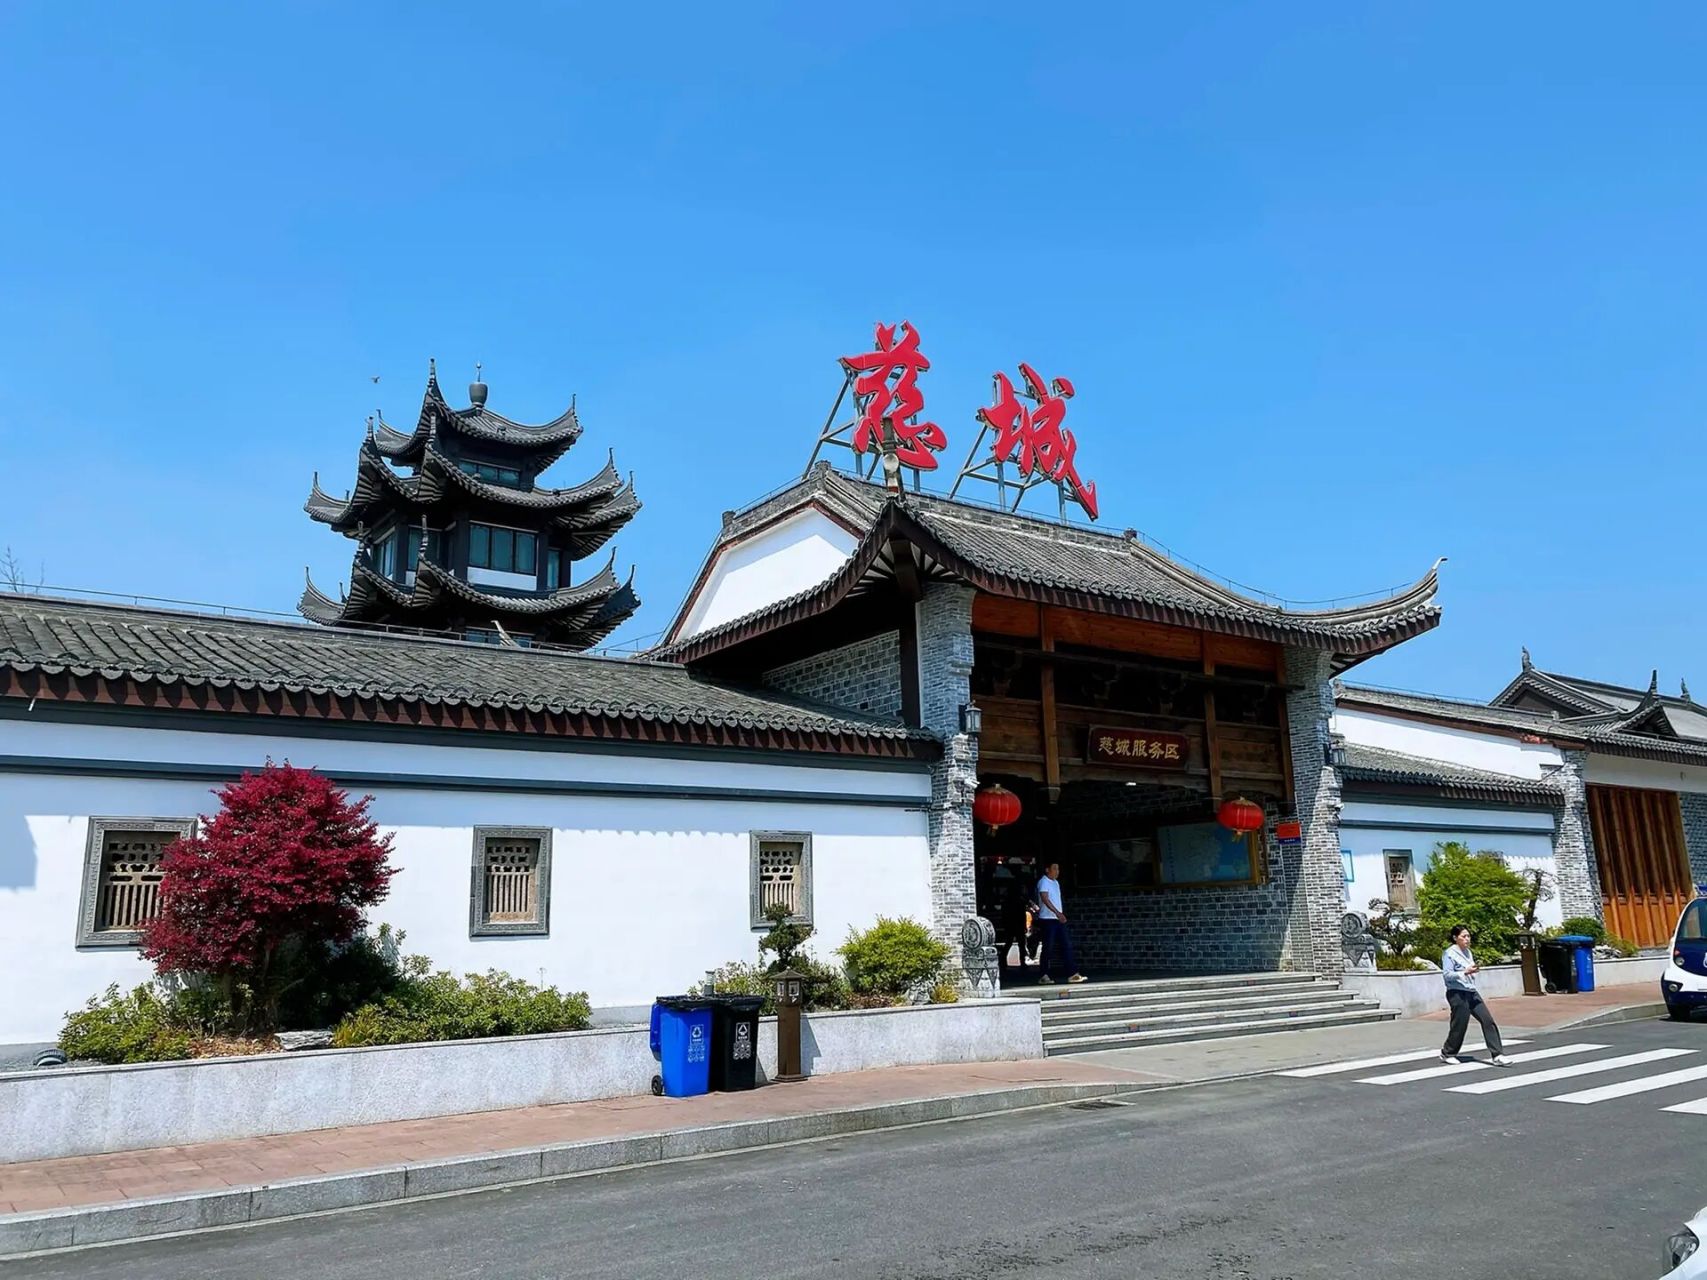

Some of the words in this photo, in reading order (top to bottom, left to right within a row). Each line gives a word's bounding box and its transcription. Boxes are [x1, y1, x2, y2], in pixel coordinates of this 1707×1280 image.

[838, 319, 1098, 522] 慈城
[1097, 736, 1180, 760] 慈城服务区
